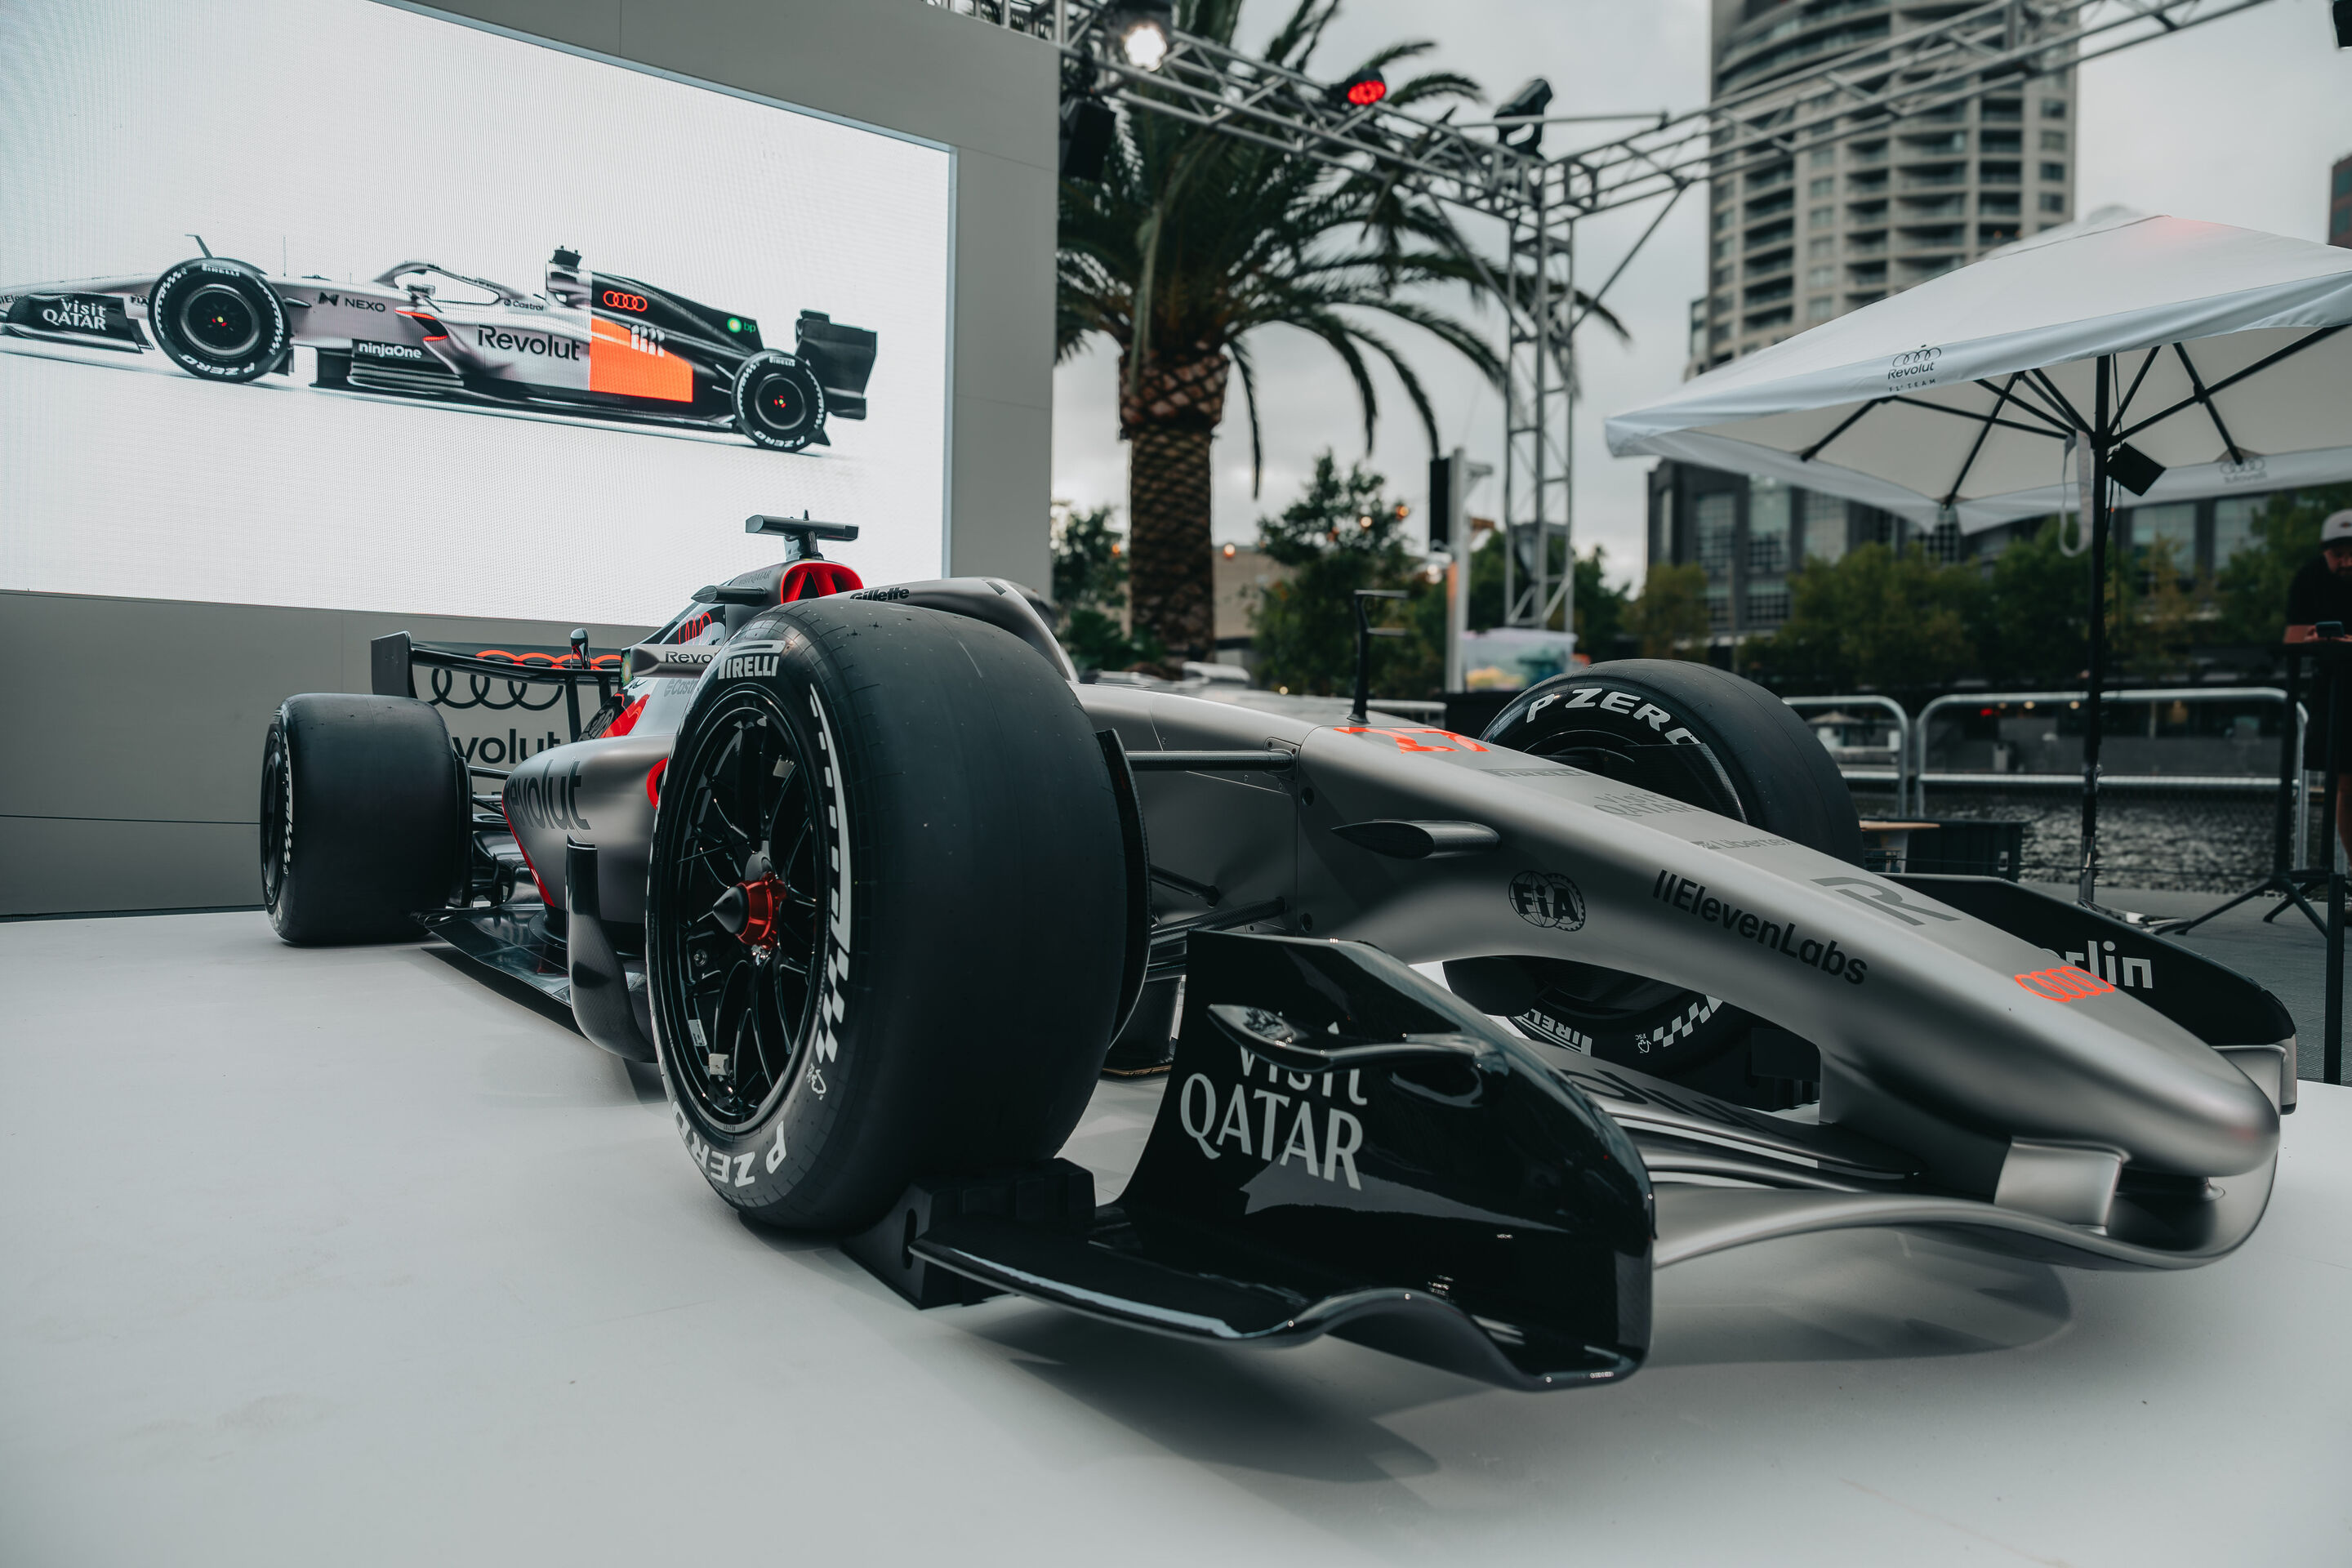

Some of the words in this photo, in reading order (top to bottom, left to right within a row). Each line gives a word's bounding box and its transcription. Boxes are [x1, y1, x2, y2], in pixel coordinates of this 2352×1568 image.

[345, 298, 385, 312] NEXO
[513, 300, 544, 312] Castrol
[42, 309, 107, 331] QATAR
[743, 322, 756, 333] bp
[359, 342, 422, 359] ninjaOne
[478, 323, 580, 361] Revolut
[1887, 362, 1935, 380] Revolut
[850, 586, 911, 602] Gillette
[717, 639, 786, 679] PIRELLI
[1526, 693, 1555, 724] P
[1593, 803, 1705, 817] QATAR
[1710, 838, 1795, 849] Libertex
[1180, 1072, 1363, 1192] QATAR
[671, 1100, 756, 1188] ZERO
[765, 1120, 787, 1174] P
